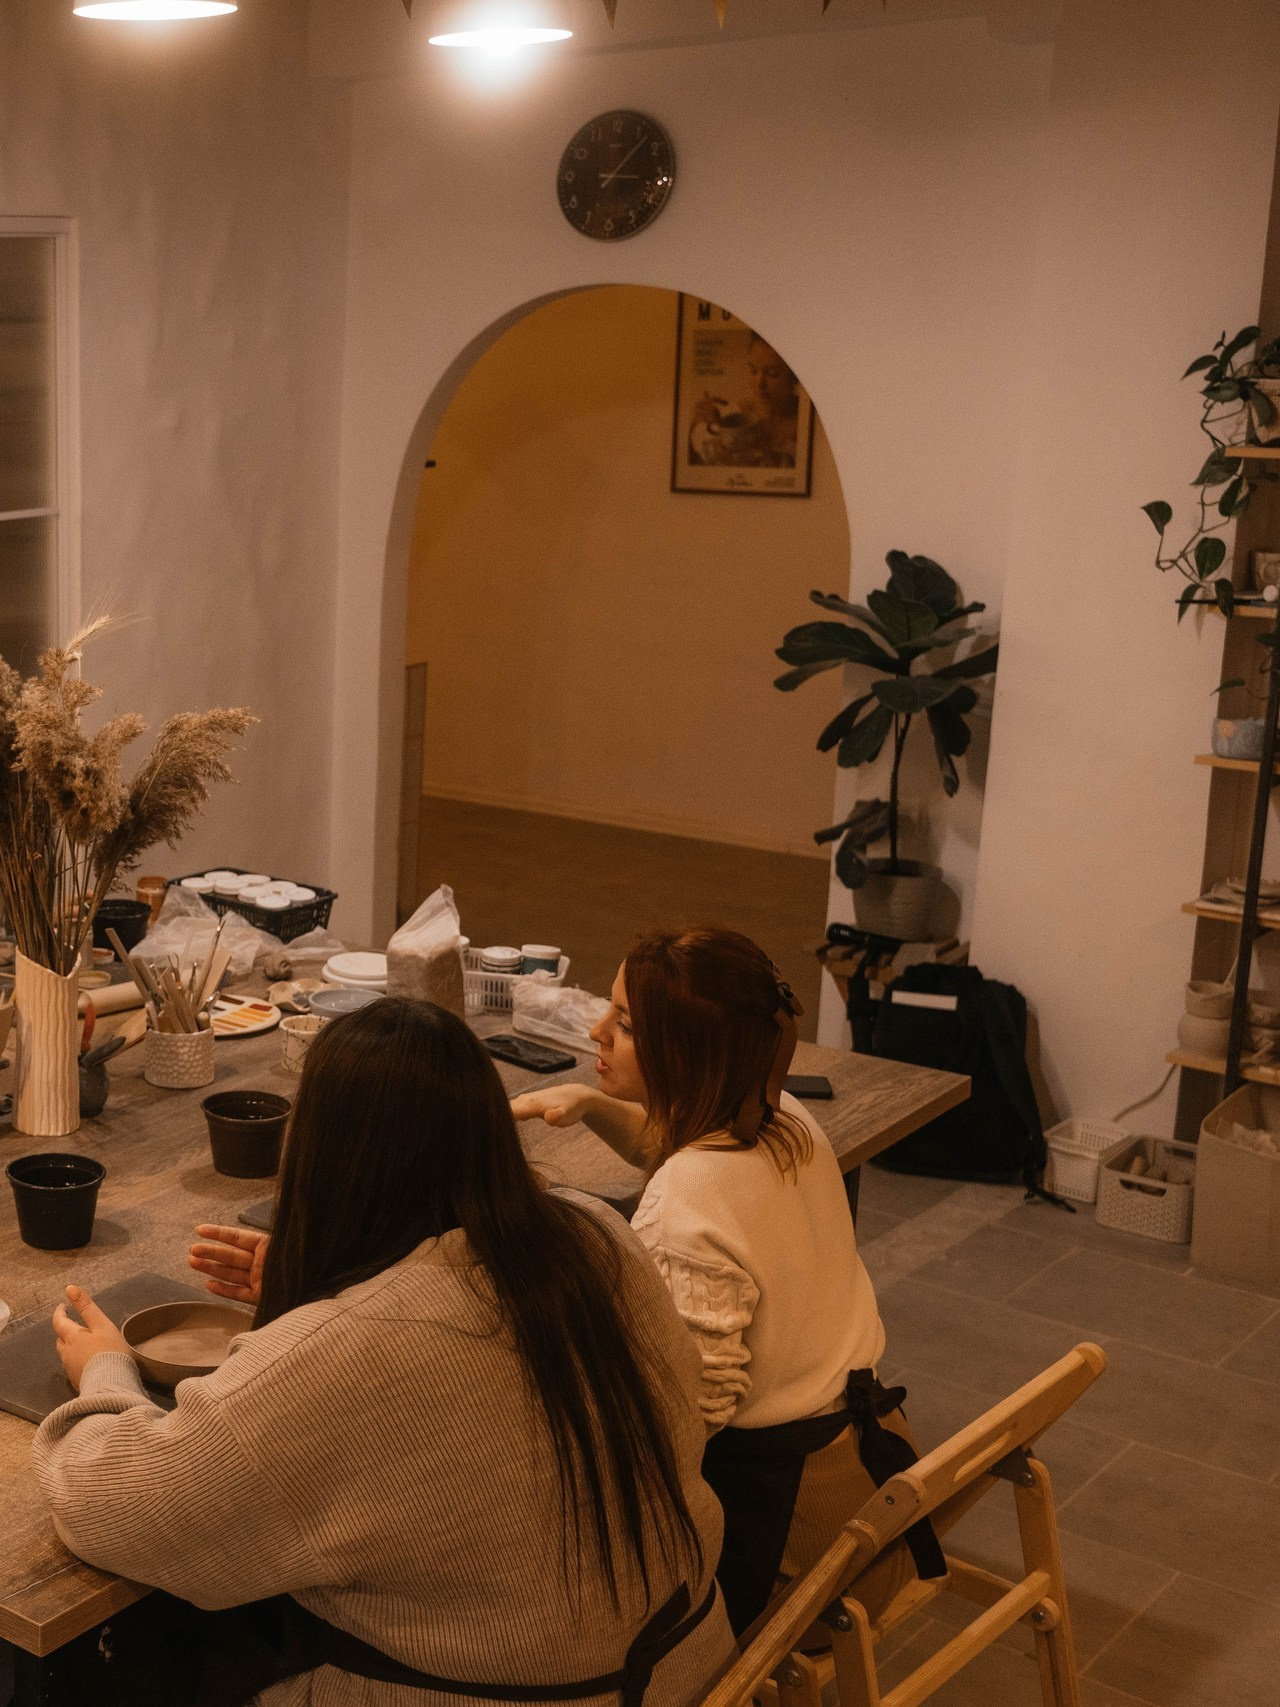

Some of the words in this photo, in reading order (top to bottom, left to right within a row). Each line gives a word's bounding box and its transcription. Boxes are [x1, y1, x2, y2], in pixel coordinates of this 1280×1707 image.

[650, 142, 658, 156] 2
[627, 209, 636, 224] 5
[603, 219, 614, 231] 6
